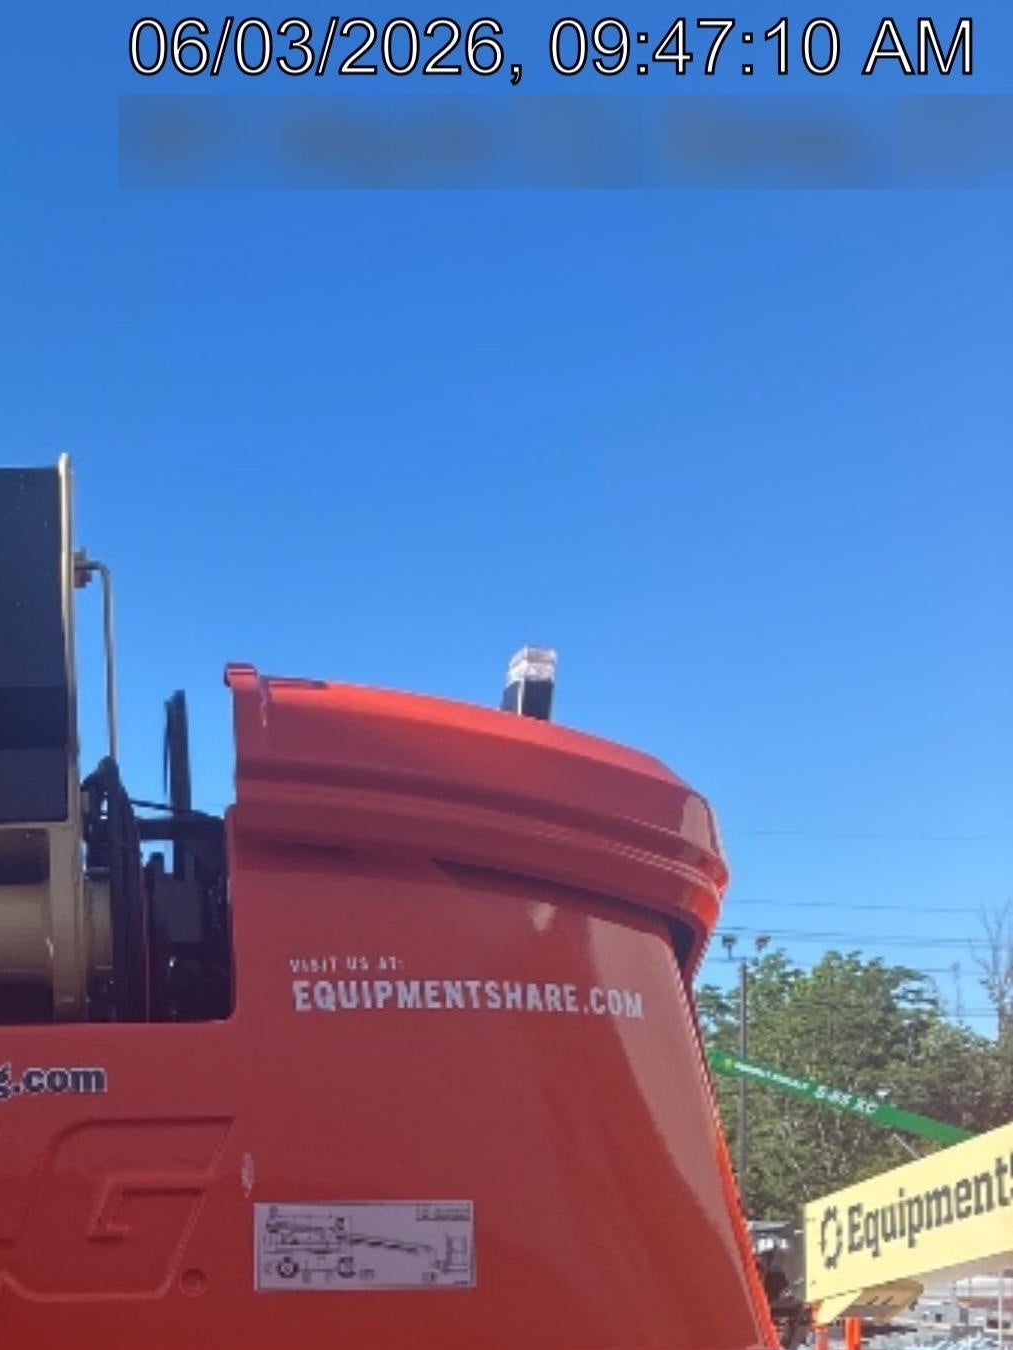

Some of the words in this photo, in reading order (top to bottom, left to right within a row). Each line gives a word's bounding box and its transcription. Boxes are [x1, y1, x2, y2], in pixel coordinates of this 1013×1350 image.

[289, 957, 337, 973] VISIT
[346, 956, 369, 971] US
[292, 980, 644, 1018] EQUIPMENTSHARE.COM
[848, 1152, 1013, 1258] Equipment
